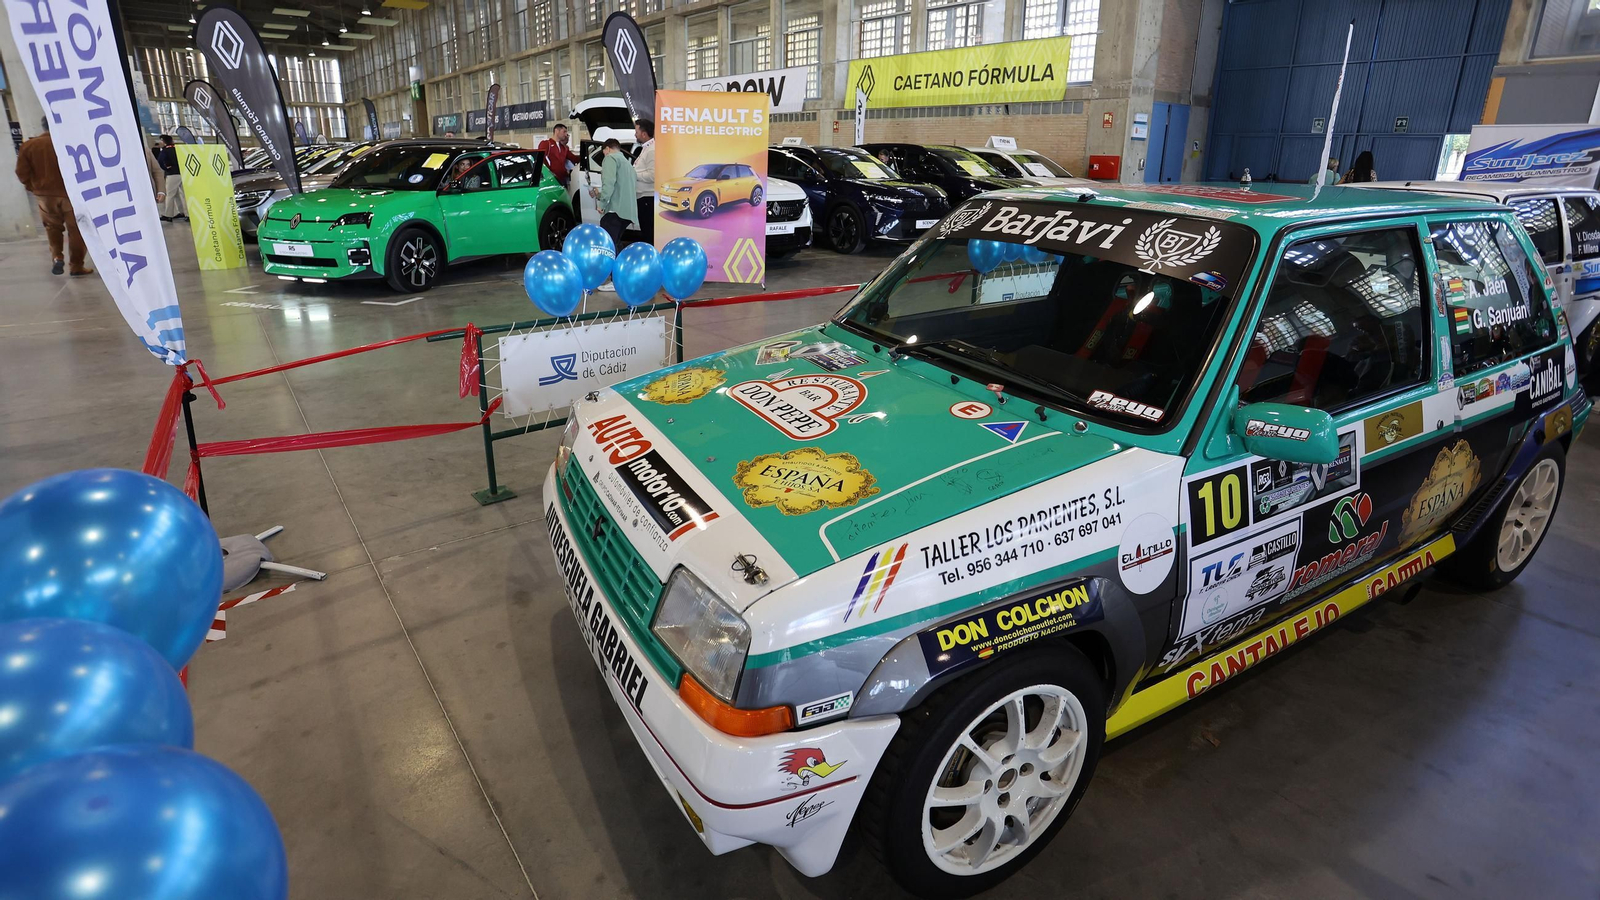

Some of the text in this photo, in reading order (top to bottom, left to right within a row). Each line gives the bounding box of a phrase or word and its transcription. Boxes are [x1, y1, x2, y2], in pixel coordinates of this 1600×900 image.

[893, 63, 1054, 91] CAETANO FÓRMULA
[660, 107, 763, 124] RENAULT 5
[661, 124, 762, 137] E-TECH ELECTRIC
[1465, 171, 1514, 181] RECAMBIOS
[1524, 167, 1589, 177] SUMINISTROS
[205, 197, 222, 263] Caetano Fórmula
[229, 197, 244, 260] Caetano Fórmula
[1469, 275, 1508, 299] A. Jaén
[1473, 301, 1528, 329] G. Sanjuán
[582, 362, 627, 379] de Cádiz
[1529, 358, 1562, 400] CANIBAL
[740, 385, 823, 433] DON PEPE
[787, 376, 860, 412] RESTAURANTE
[799, 389, 822, 402] BAR
[957, 403, 984, 416] E
[587, 414, 652, 465] AUTO
[760, 464, 845, 492] ESPAÑA
[608, 472, 669, 552] automóviles de confianza
[1198, 473, 1242, 537] 10
[1417, 482, 1465, 519] ESPAÑA
[921, 486, 1126, 569] TALLER LOS PARIENTES, S.L.
[1267, 532, 1297, 555] CASTILLO
[939, 512, 1122, 585] Tel. 956 344 710 637 697 041
[1122, 553, 1135, 564] EL
[1288, 520, 1389, 592] romeral
[546, 501, 595, 620] AUTOESCUELA
[590, 601, 649, 717] GABRIEL
[936, 584, 1090, 651] DON COLCHON
[971, 611, 1073, 652] www.doncolchonoutlet.com
[997, 619, 1077, 653] PRODUCTO NACIONAL
[1185, 601, 1341, 700] CANTALEJO
